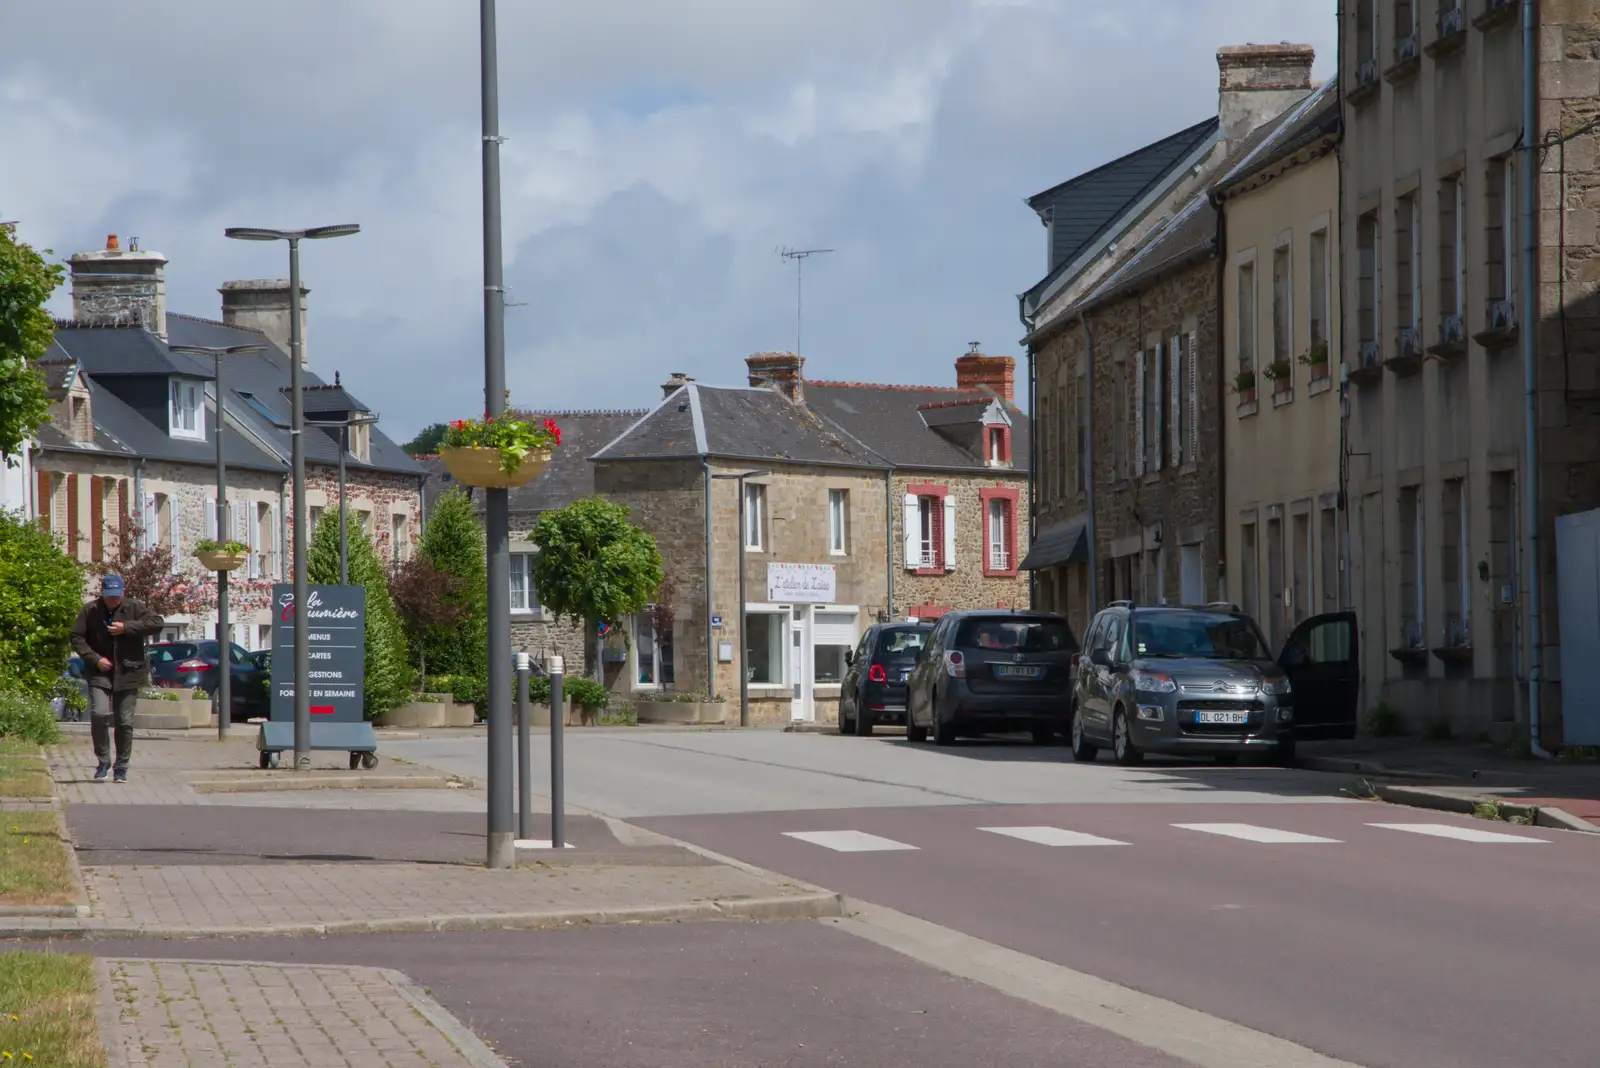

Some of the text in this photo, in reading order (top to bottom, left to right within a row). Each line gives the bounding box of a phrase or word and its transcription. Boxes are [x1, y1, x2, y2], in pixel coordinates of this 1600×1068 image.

[774, 575, 801, 589] L'atelier
[802, 576, 810, 589] de
[324, 690, 356, 698] SEMAINE
